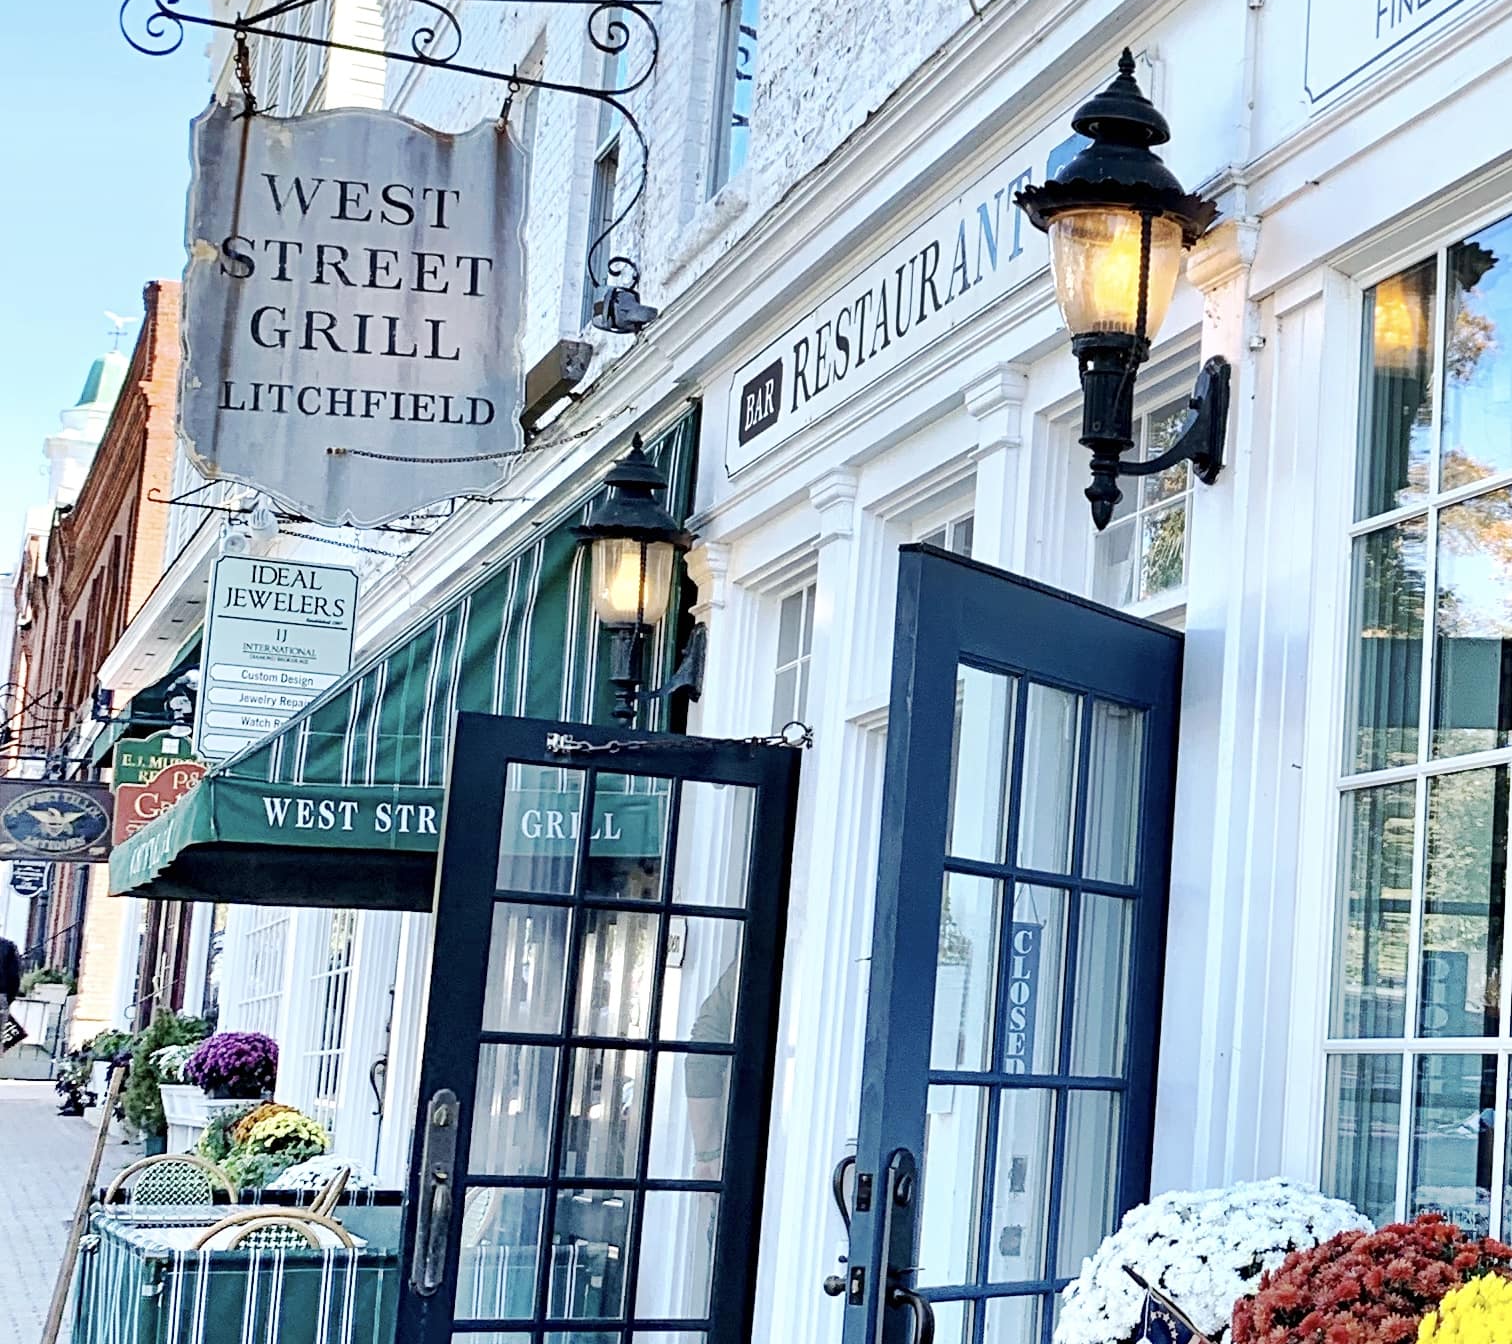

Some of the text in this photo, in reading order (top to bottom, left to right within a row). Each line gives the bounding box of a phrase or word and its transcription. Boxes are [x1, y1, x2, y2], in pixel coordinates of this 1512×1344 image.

[261, 172, 461, 230] WEST
[219, 235, 493, 298] STREET
[745, 166, 1033, 432] BAR RESTAURANT
[249, 305, 462, 363] GRILL
[218, 380, 496, 427] LITCHFIELD
[251, 564, 323, 591] IDEAL
[224, 587, 346, 618] JEWELERS
[241, 669, 314, 687] Custom Design
[239, 692, 277, 706] Jewelry
[241, 716, 271, 728] Watch
[262, 796, 358, 831] WEST
[375, 802, 438, 834] STR
